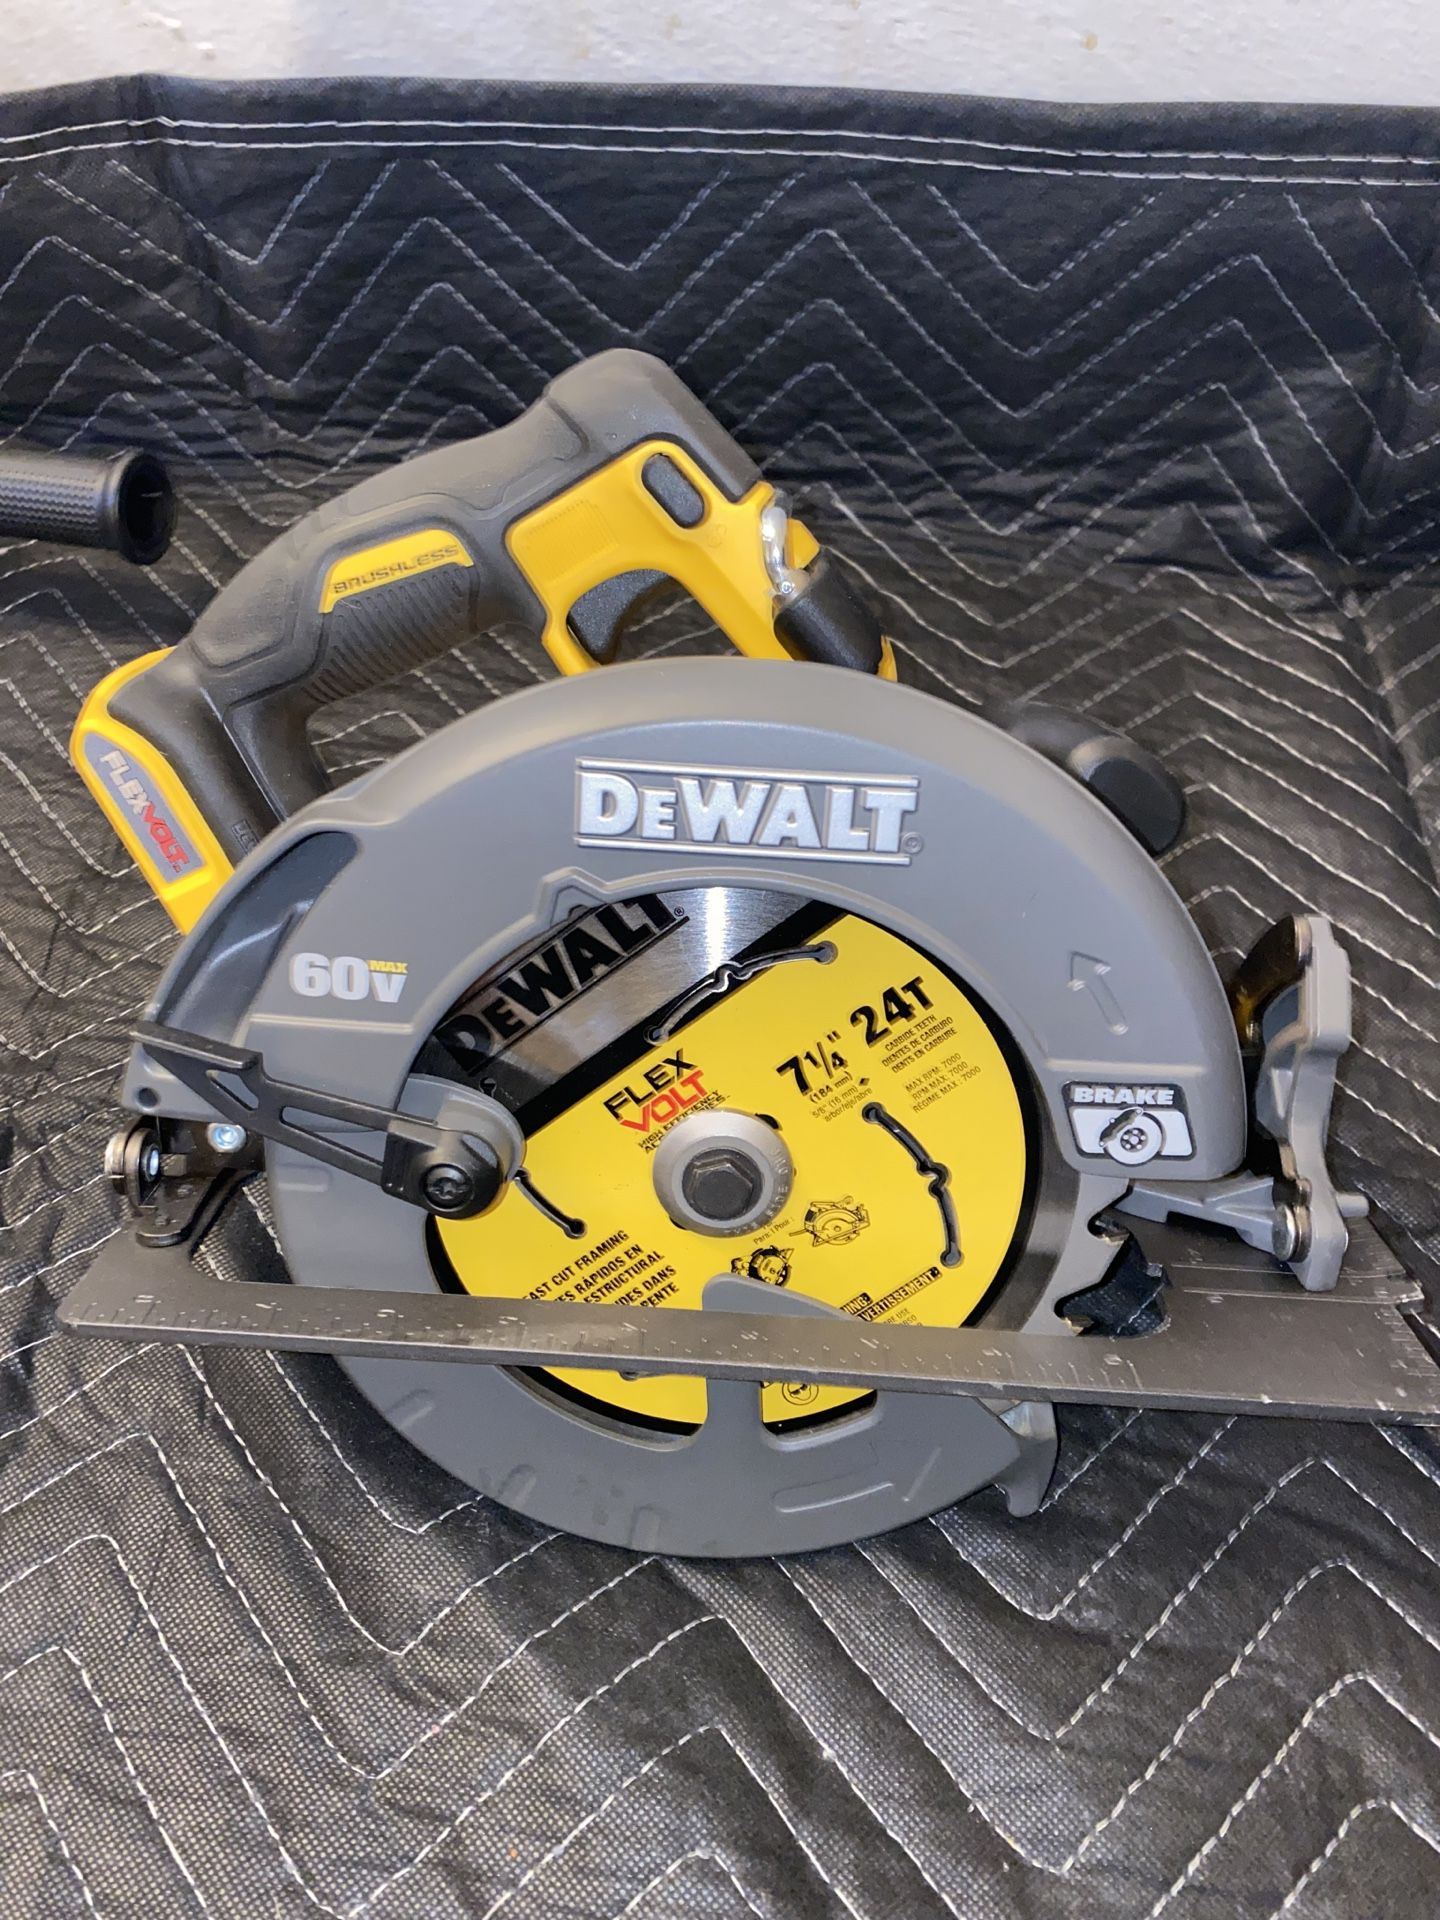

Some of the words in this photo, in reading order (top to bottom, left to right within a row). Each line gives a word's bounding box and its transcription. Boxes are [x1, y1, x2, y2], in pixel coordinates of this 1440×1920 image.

[333, 545, 459, 594] BRUSHLESS
[368, 960, 408, 974] MAX
[850, 976, 934, 1048] 24T
[885, 1028, 915, 1052] CARBIDE
[914, 1014, 937, 1038] TEETH
[881, 1044, 911, 1068] DIENTES
[909, 1038, 923, 1051] DE
[920, 1016, 954, 1043] CARBURO
[891, 1053, 916, 1074] DENTS
[914, 1049, 926, 1060] EN
[923, 1027, 957, 1054] CARBURE
[603, 1048, 698, 1121] FLEX
[809, 1084, 834, 1104] (184
[833, 1070, 854, 1089] mm)
[905, 1076, 924, 1093] MAX
[941, 1053, 962, 1070] 7000
[912, 1085, 931, 1102] RPM
[949, 1061, 969, 1078] 7000
[963, 1066, 982, 1084] 7000
[1071, 1085, 1174, 1105] BRAKE
[619, 1069, 709, 1133] VOLT
[638, 1128, 663, 1149] HIGH
[662, 1090, 720, 1131] EFFICIENCY
[551, 1266, 576, 1287] CUT
[574, 1229, 630, 1271] FRAMING
[624, 1244, 644, 1261] EN
[583, 1250, 666, 1304] ESTRUCTURAL
[642, 1265, 677, 1291] DANS
